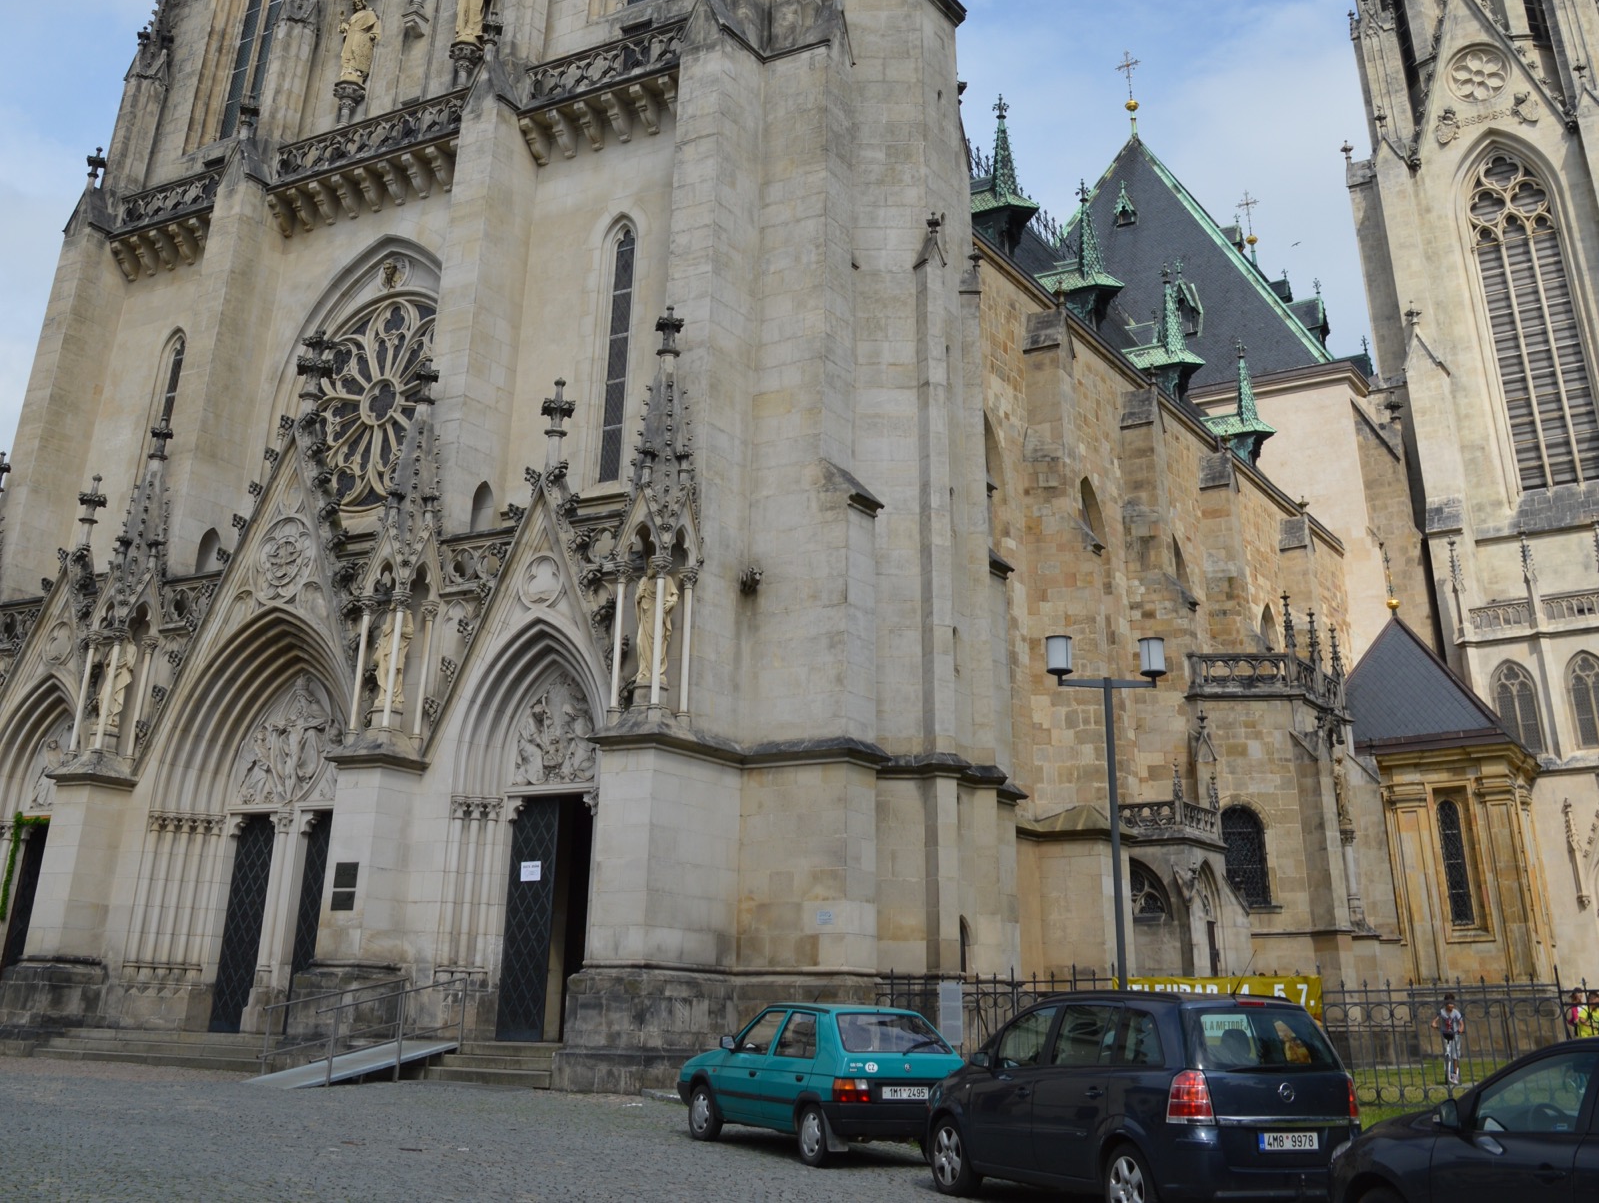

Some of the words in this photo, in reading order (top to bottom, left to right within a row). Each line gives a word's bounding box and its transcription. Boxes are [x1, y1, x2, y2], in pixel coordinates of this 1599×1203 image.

[867, 1063, 876, 1071] CZ
[1267, 1134, 1284, 1148] 4M8
[1291, 1134, 1314, 1148] 9978
